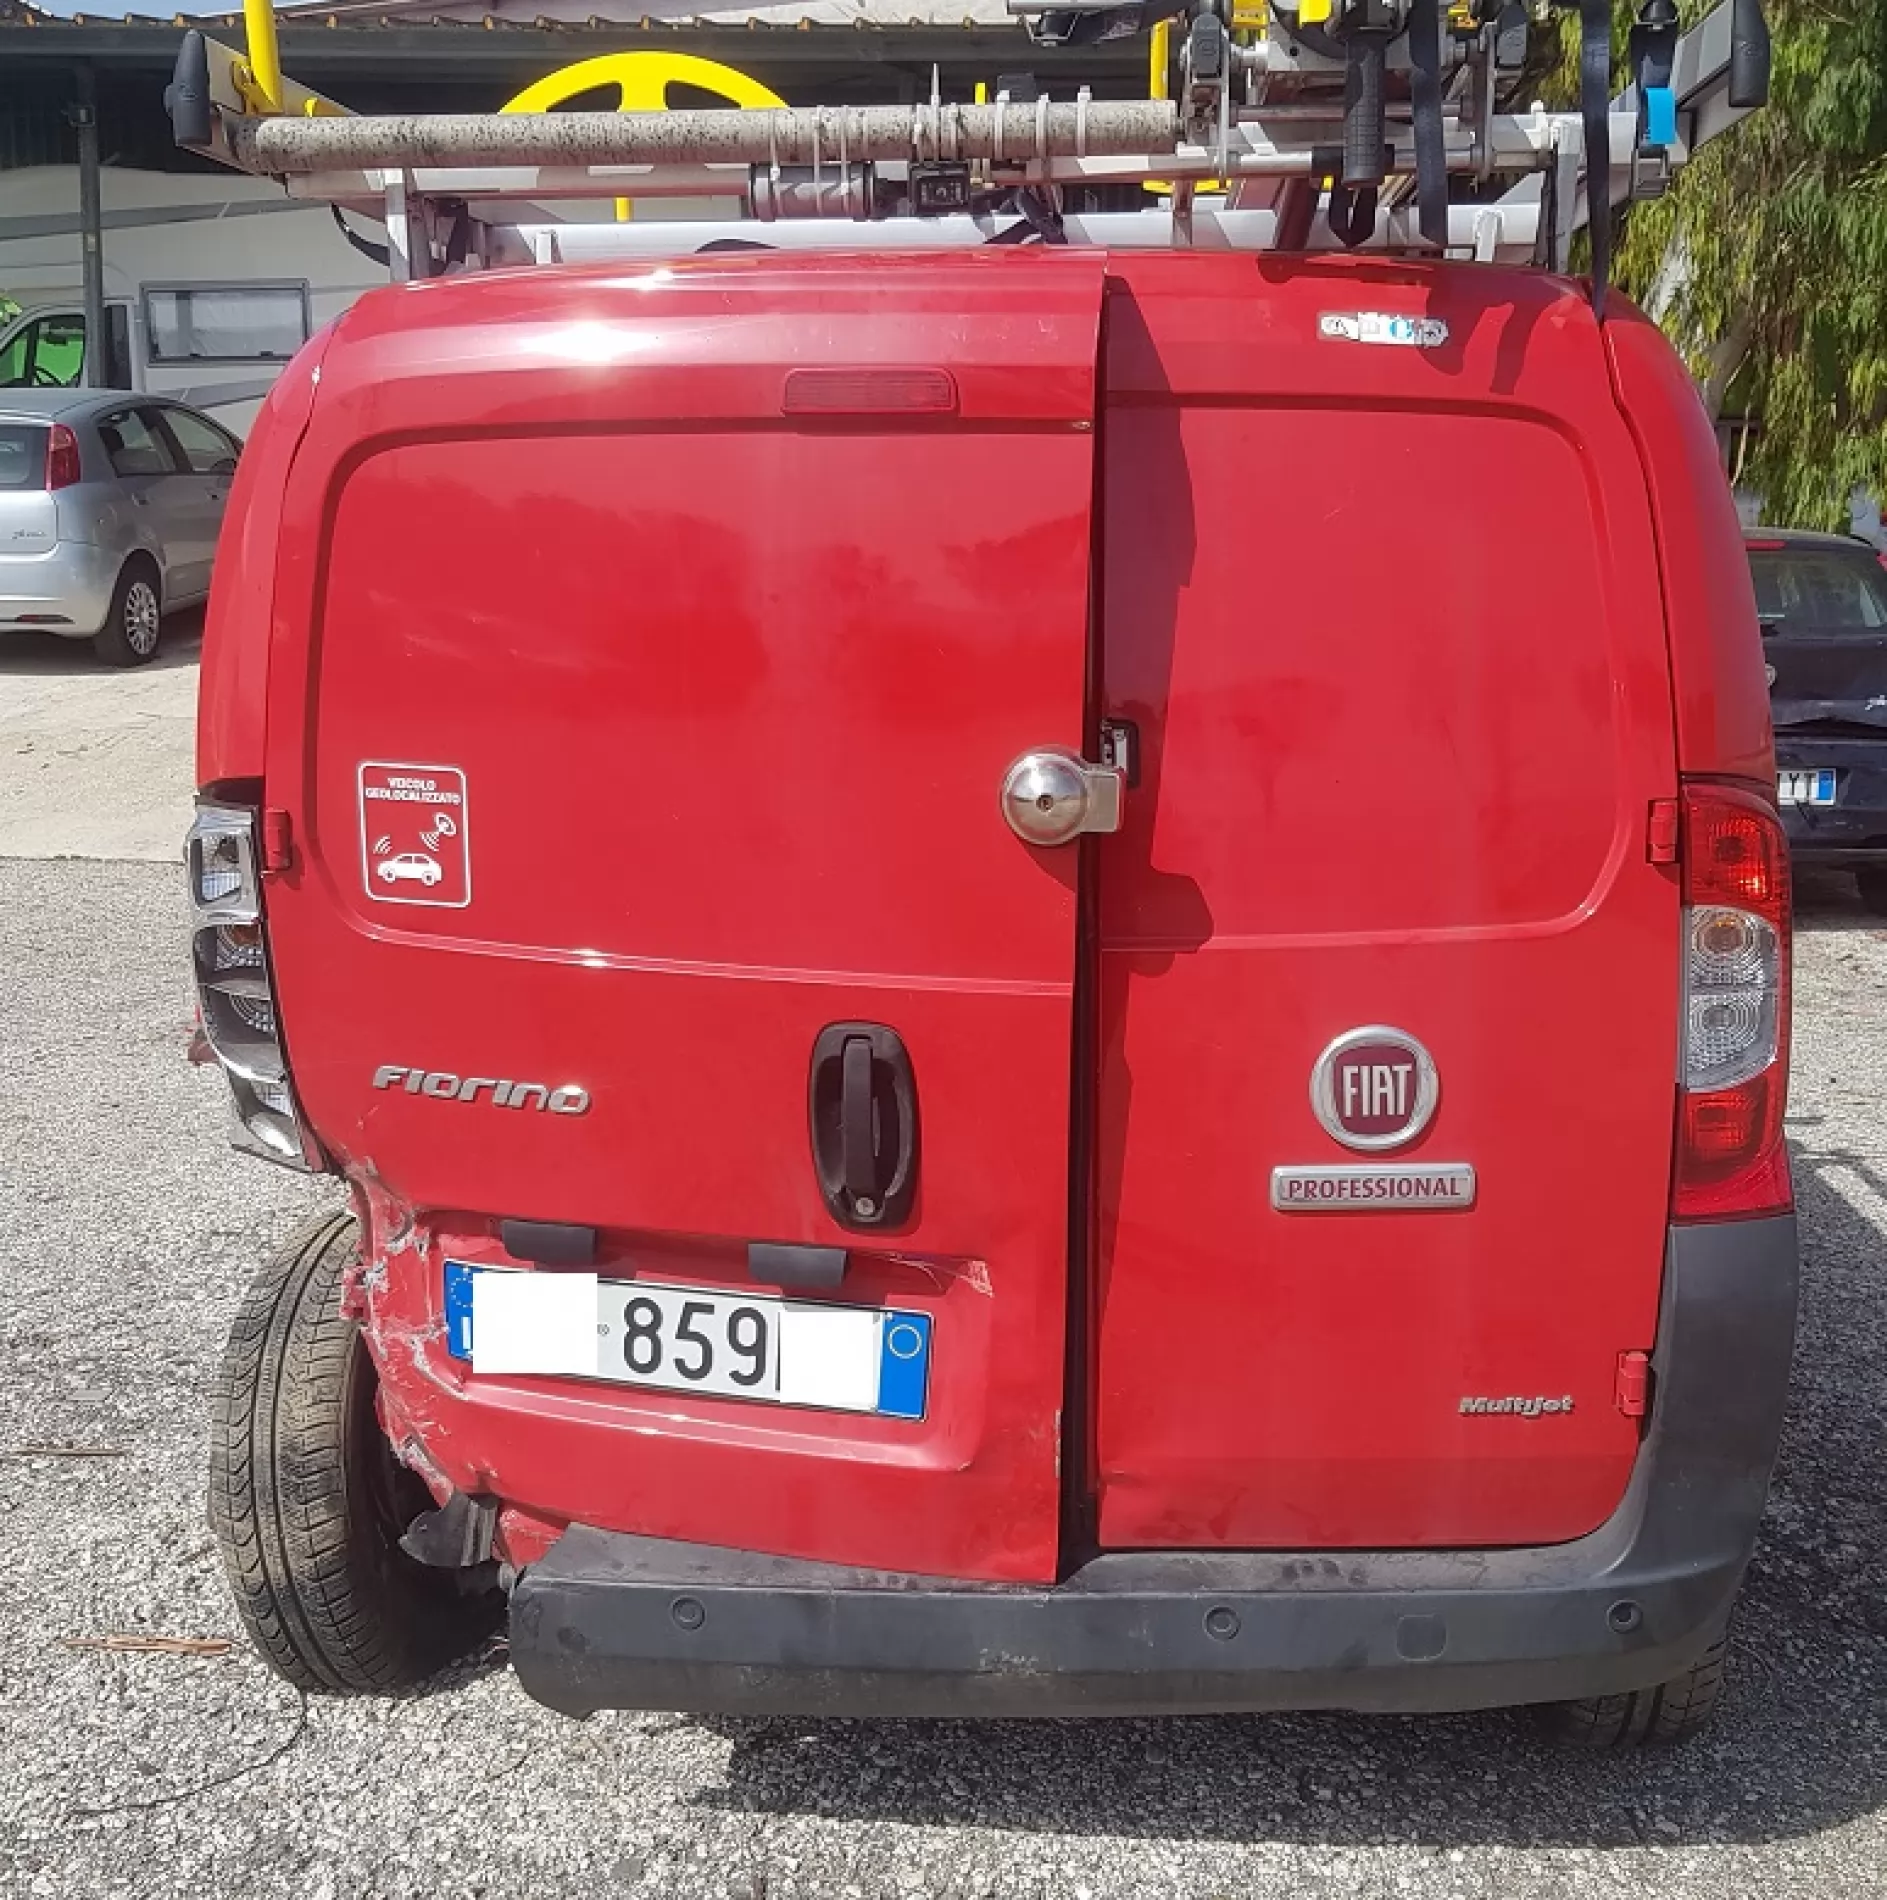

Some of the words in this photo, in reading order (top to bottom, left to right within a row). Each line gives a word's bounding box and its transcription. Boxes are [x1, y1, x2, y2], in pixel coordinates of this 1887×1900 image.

[1777, 772, 1817, 796] YT
[1342, 1063, 1413, 1118] FIAT
[1288, 1176, 1461, 1199] PROFESSIONAL
[622, 1296, 780, 1391] 859
